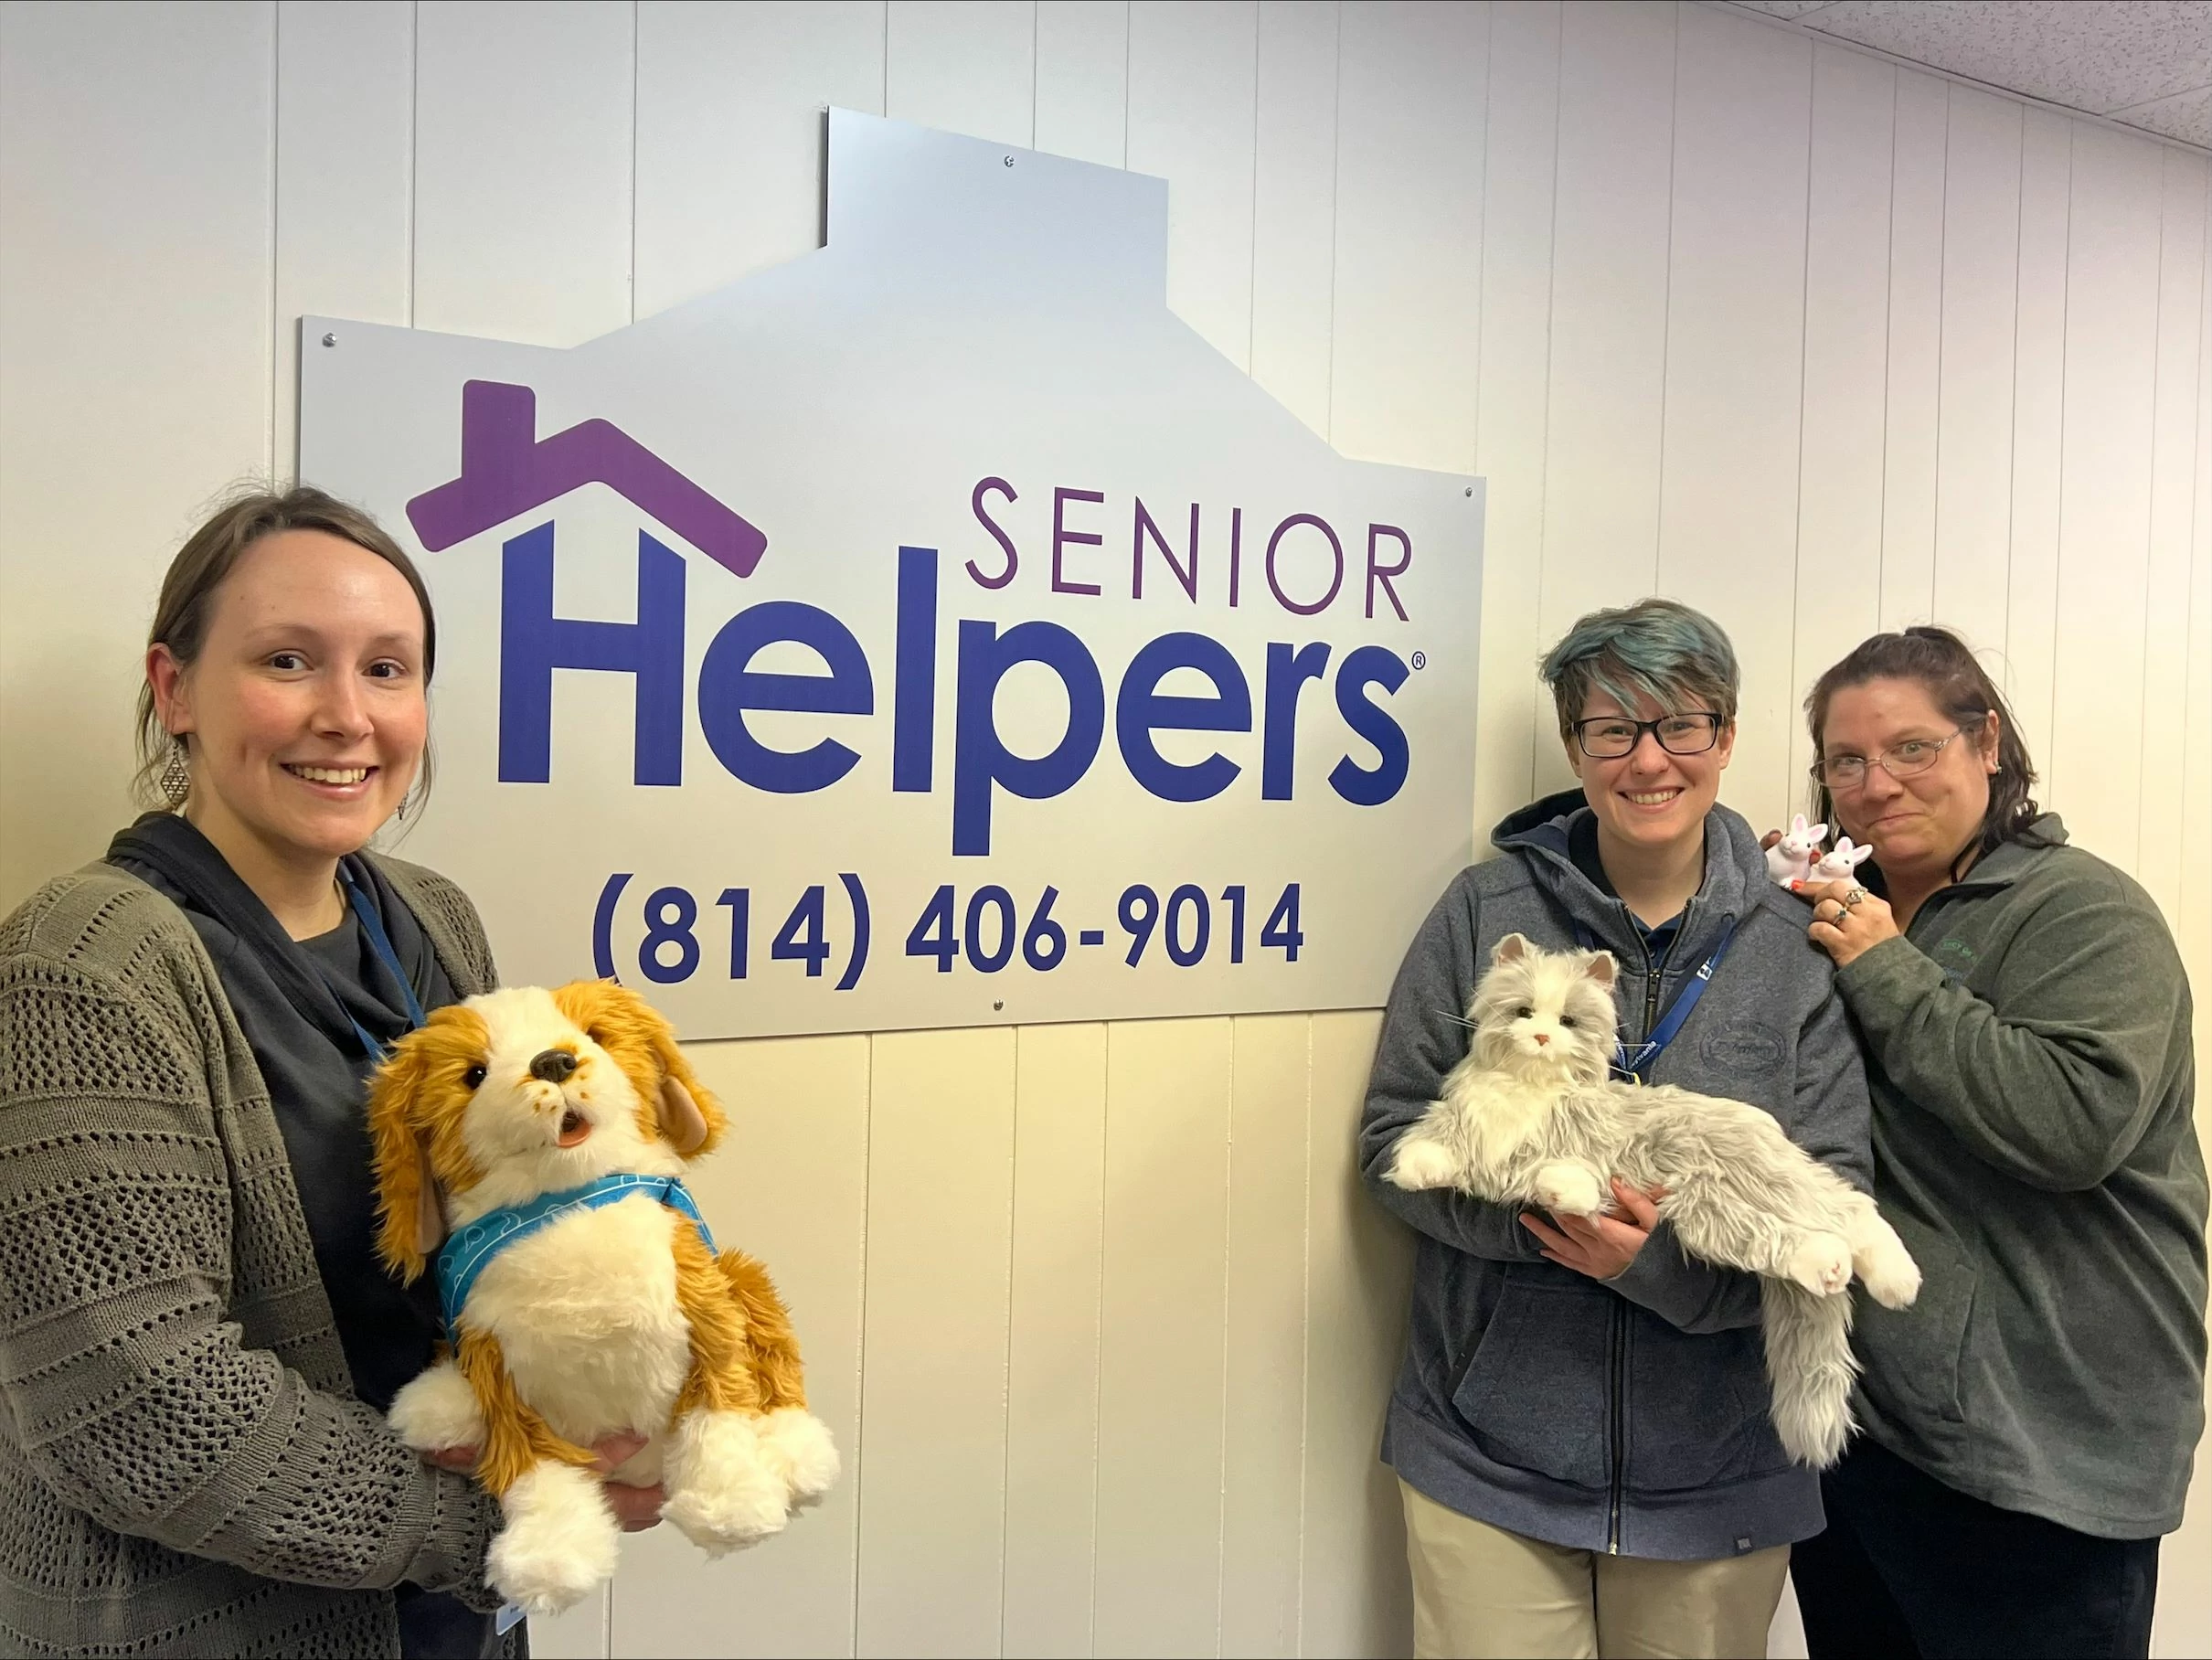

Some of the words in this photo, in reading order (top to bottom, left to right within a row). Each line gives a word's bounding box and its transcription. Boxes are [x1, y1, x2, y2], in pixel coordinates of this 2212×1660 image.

[964, 475, 1413, 622] SENIOR
[592, 873, 870, 991] (814)
[905, 883, 1304, 973] 406-9014
